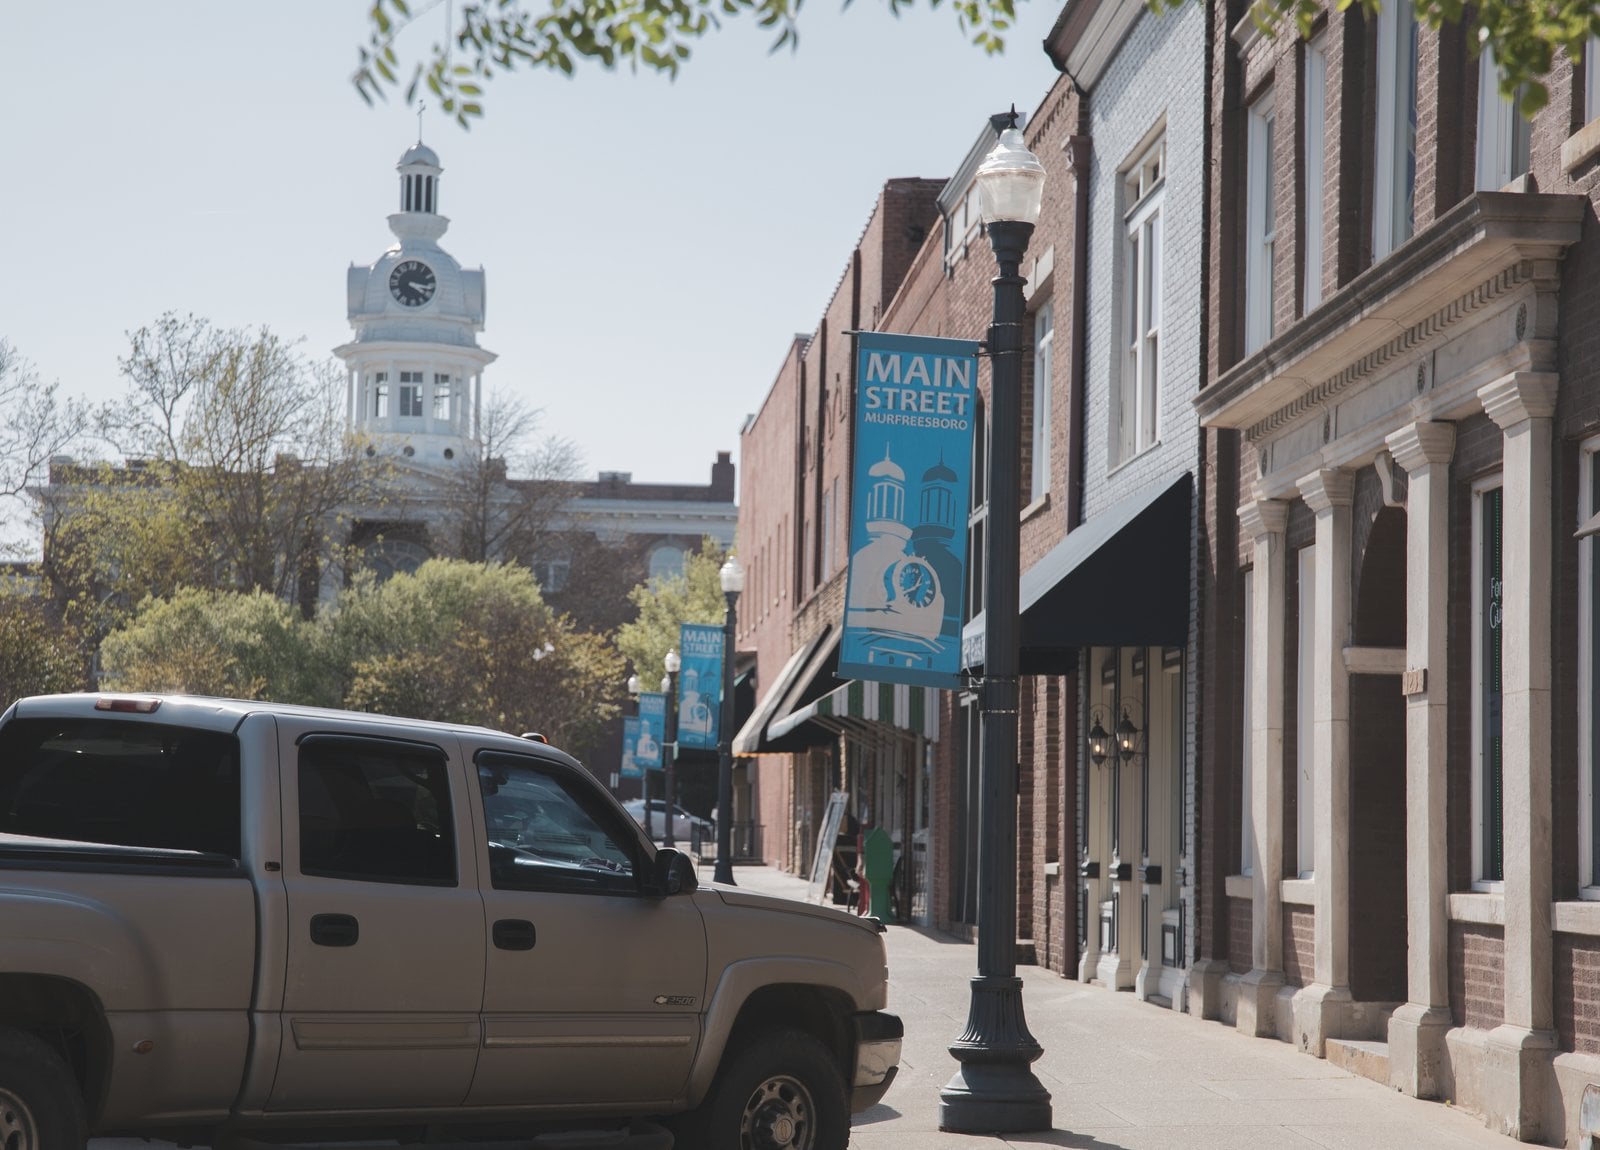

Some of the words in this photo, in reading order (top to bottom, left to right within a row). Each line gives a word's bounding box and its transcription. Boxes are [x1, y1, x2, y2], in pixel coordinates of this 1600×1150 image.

[866, 353, 971, 389] MAIN
[865, 386, 970, 415] STREET
[864, 412, 968, 430] MURFREESBORO
[683, 630, 721, 643] MAIN
[683, 643, 720, 653] STREET
